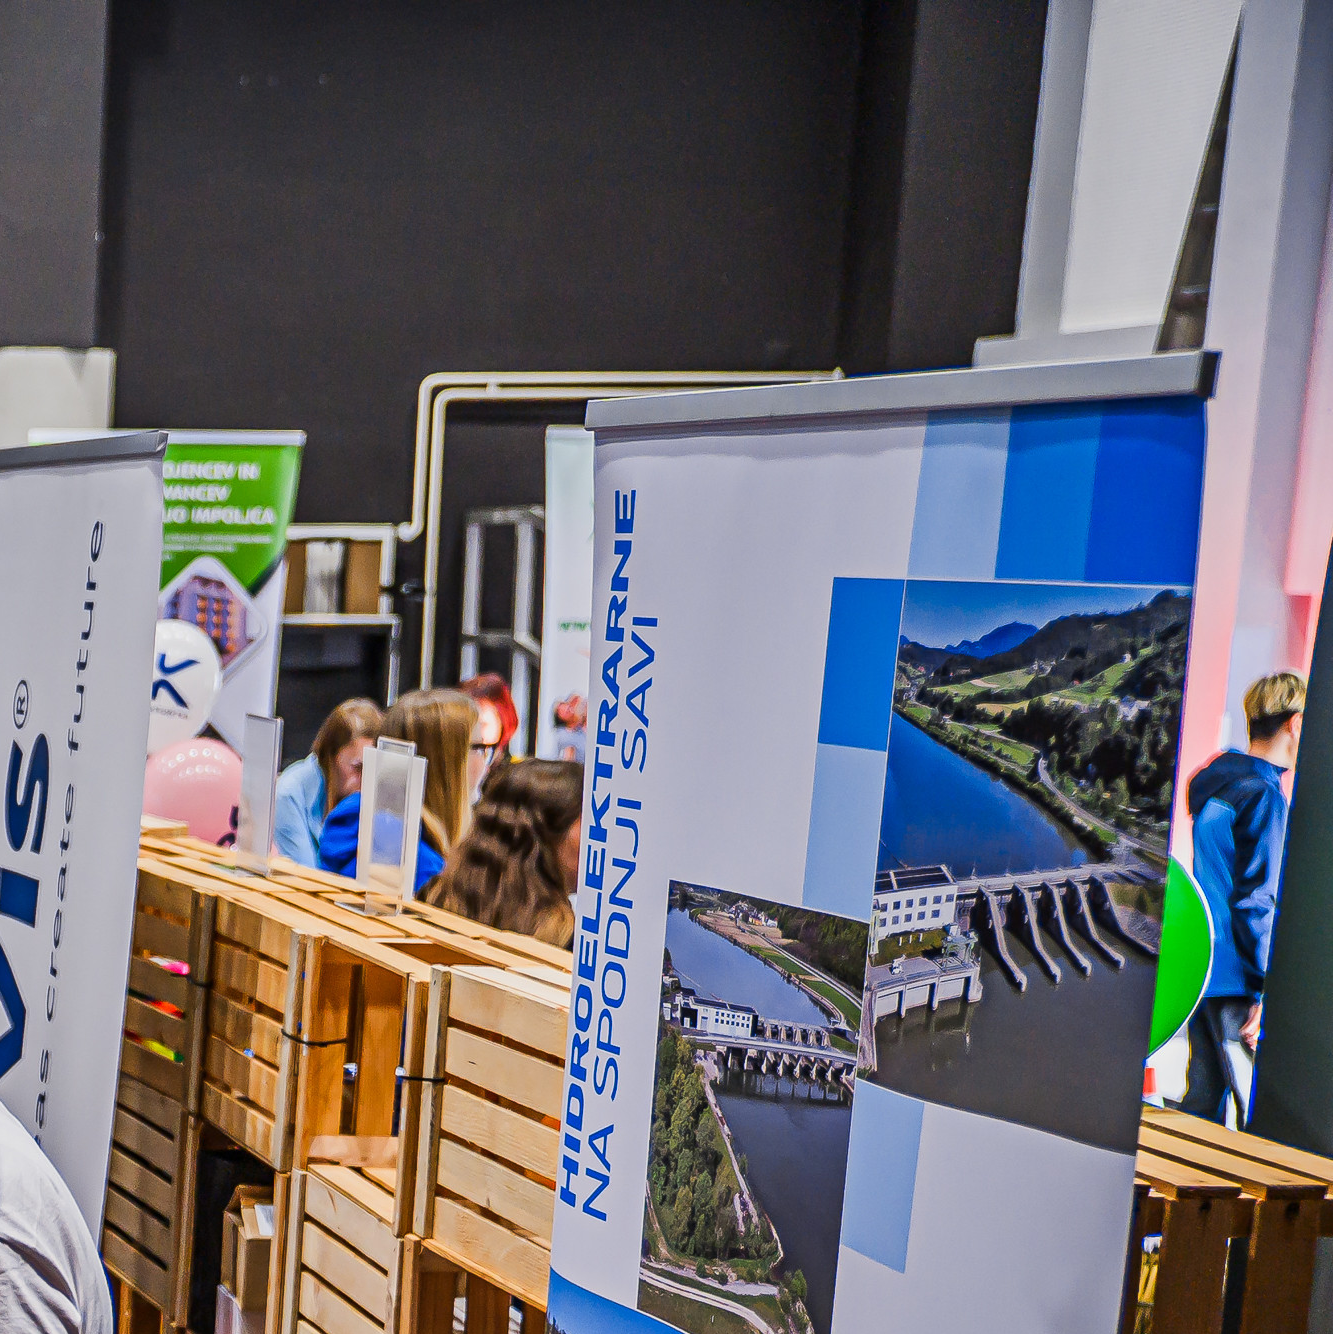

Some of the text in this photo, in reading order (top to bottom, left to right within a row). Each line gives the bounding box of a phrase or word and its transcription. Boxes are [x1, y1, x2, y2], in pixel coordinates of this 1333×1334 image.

[46, 782, 75, 1023] create
[68, 519, 105, 753] future
[559, 488, 637, 1208] HIDROELEKTRARNE
[581, 616, 659, 1222] NA SPODNJI SAVI
